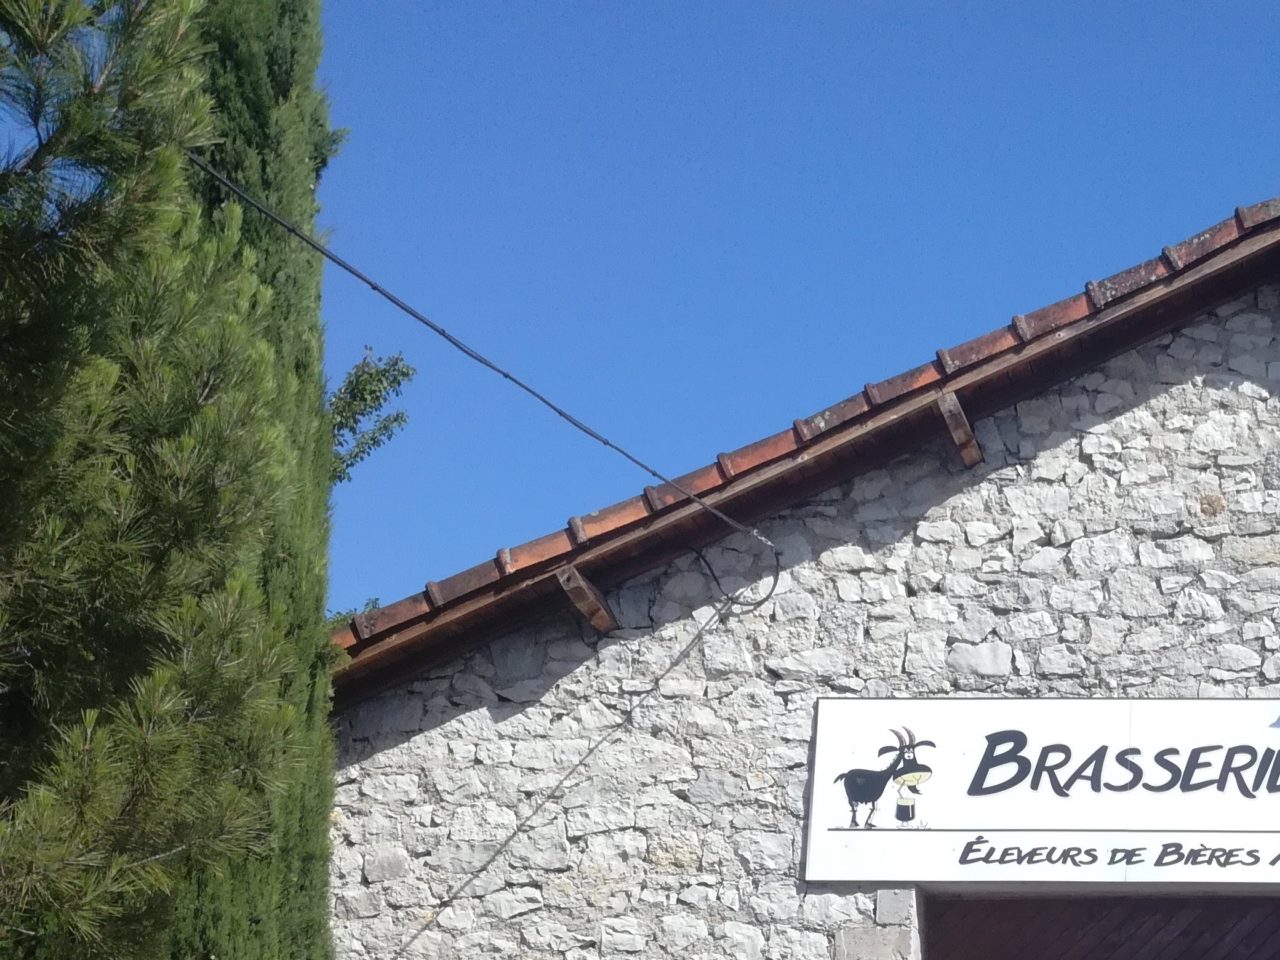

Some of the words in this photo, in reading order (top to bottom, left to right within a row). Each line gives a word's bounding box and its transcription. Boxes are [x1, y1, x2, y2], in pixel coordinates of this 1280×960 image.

[958, 835, 1098, 867] ÉLEVEURS
[1107, 847, 1147, 866] DE
[1153, 842, 1261, 868] BIÈRES
